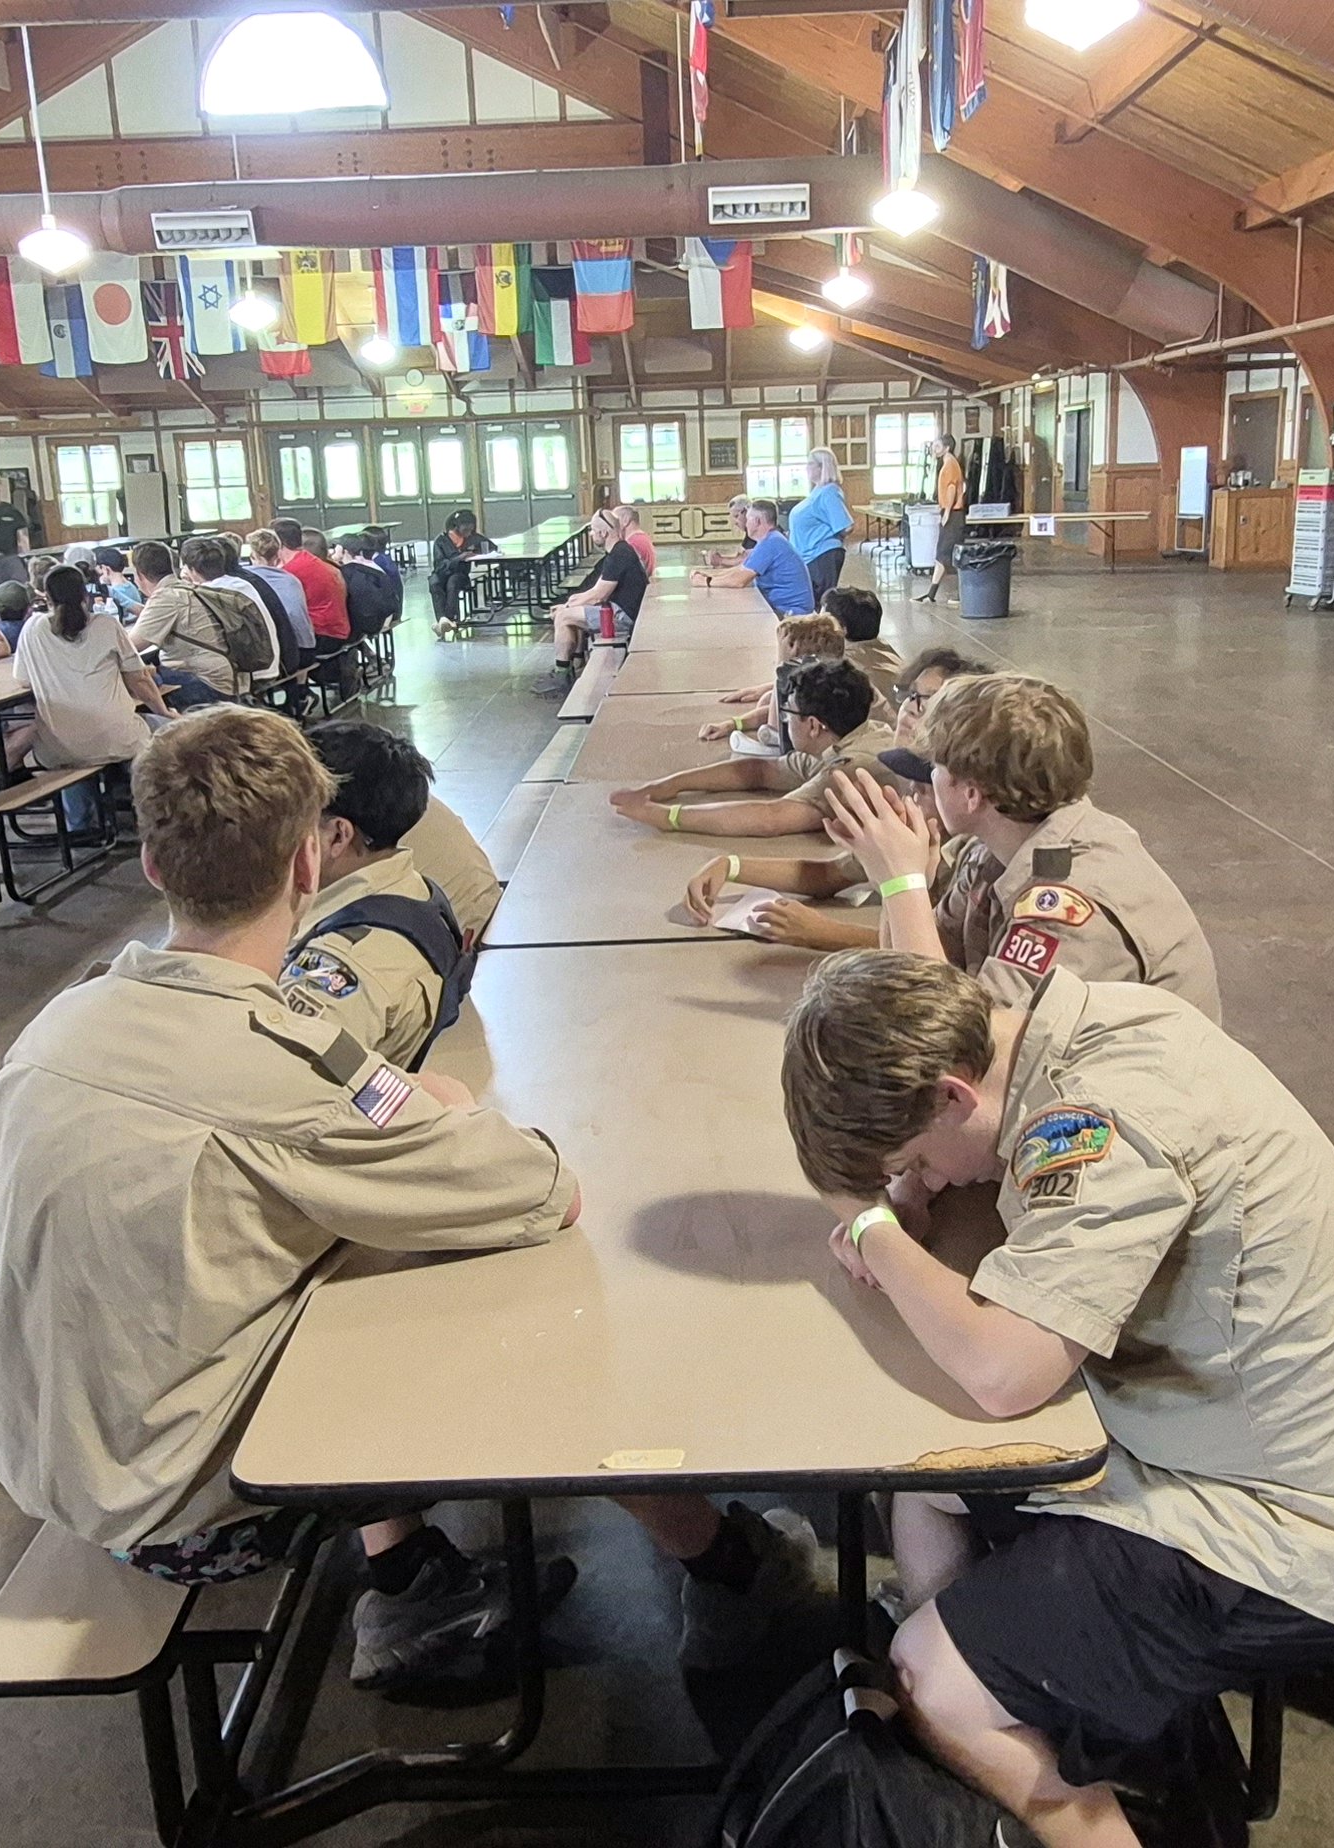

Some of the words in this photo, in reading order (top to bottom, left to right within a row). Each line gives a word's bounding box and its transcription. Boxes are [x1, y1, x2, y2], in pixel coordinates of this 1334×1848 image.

[1005, 935, 1047, 970] 302
[1047, 1112, 1085, 1123] COUNCIL
[1030, 1172, 1074, 1198] 302
